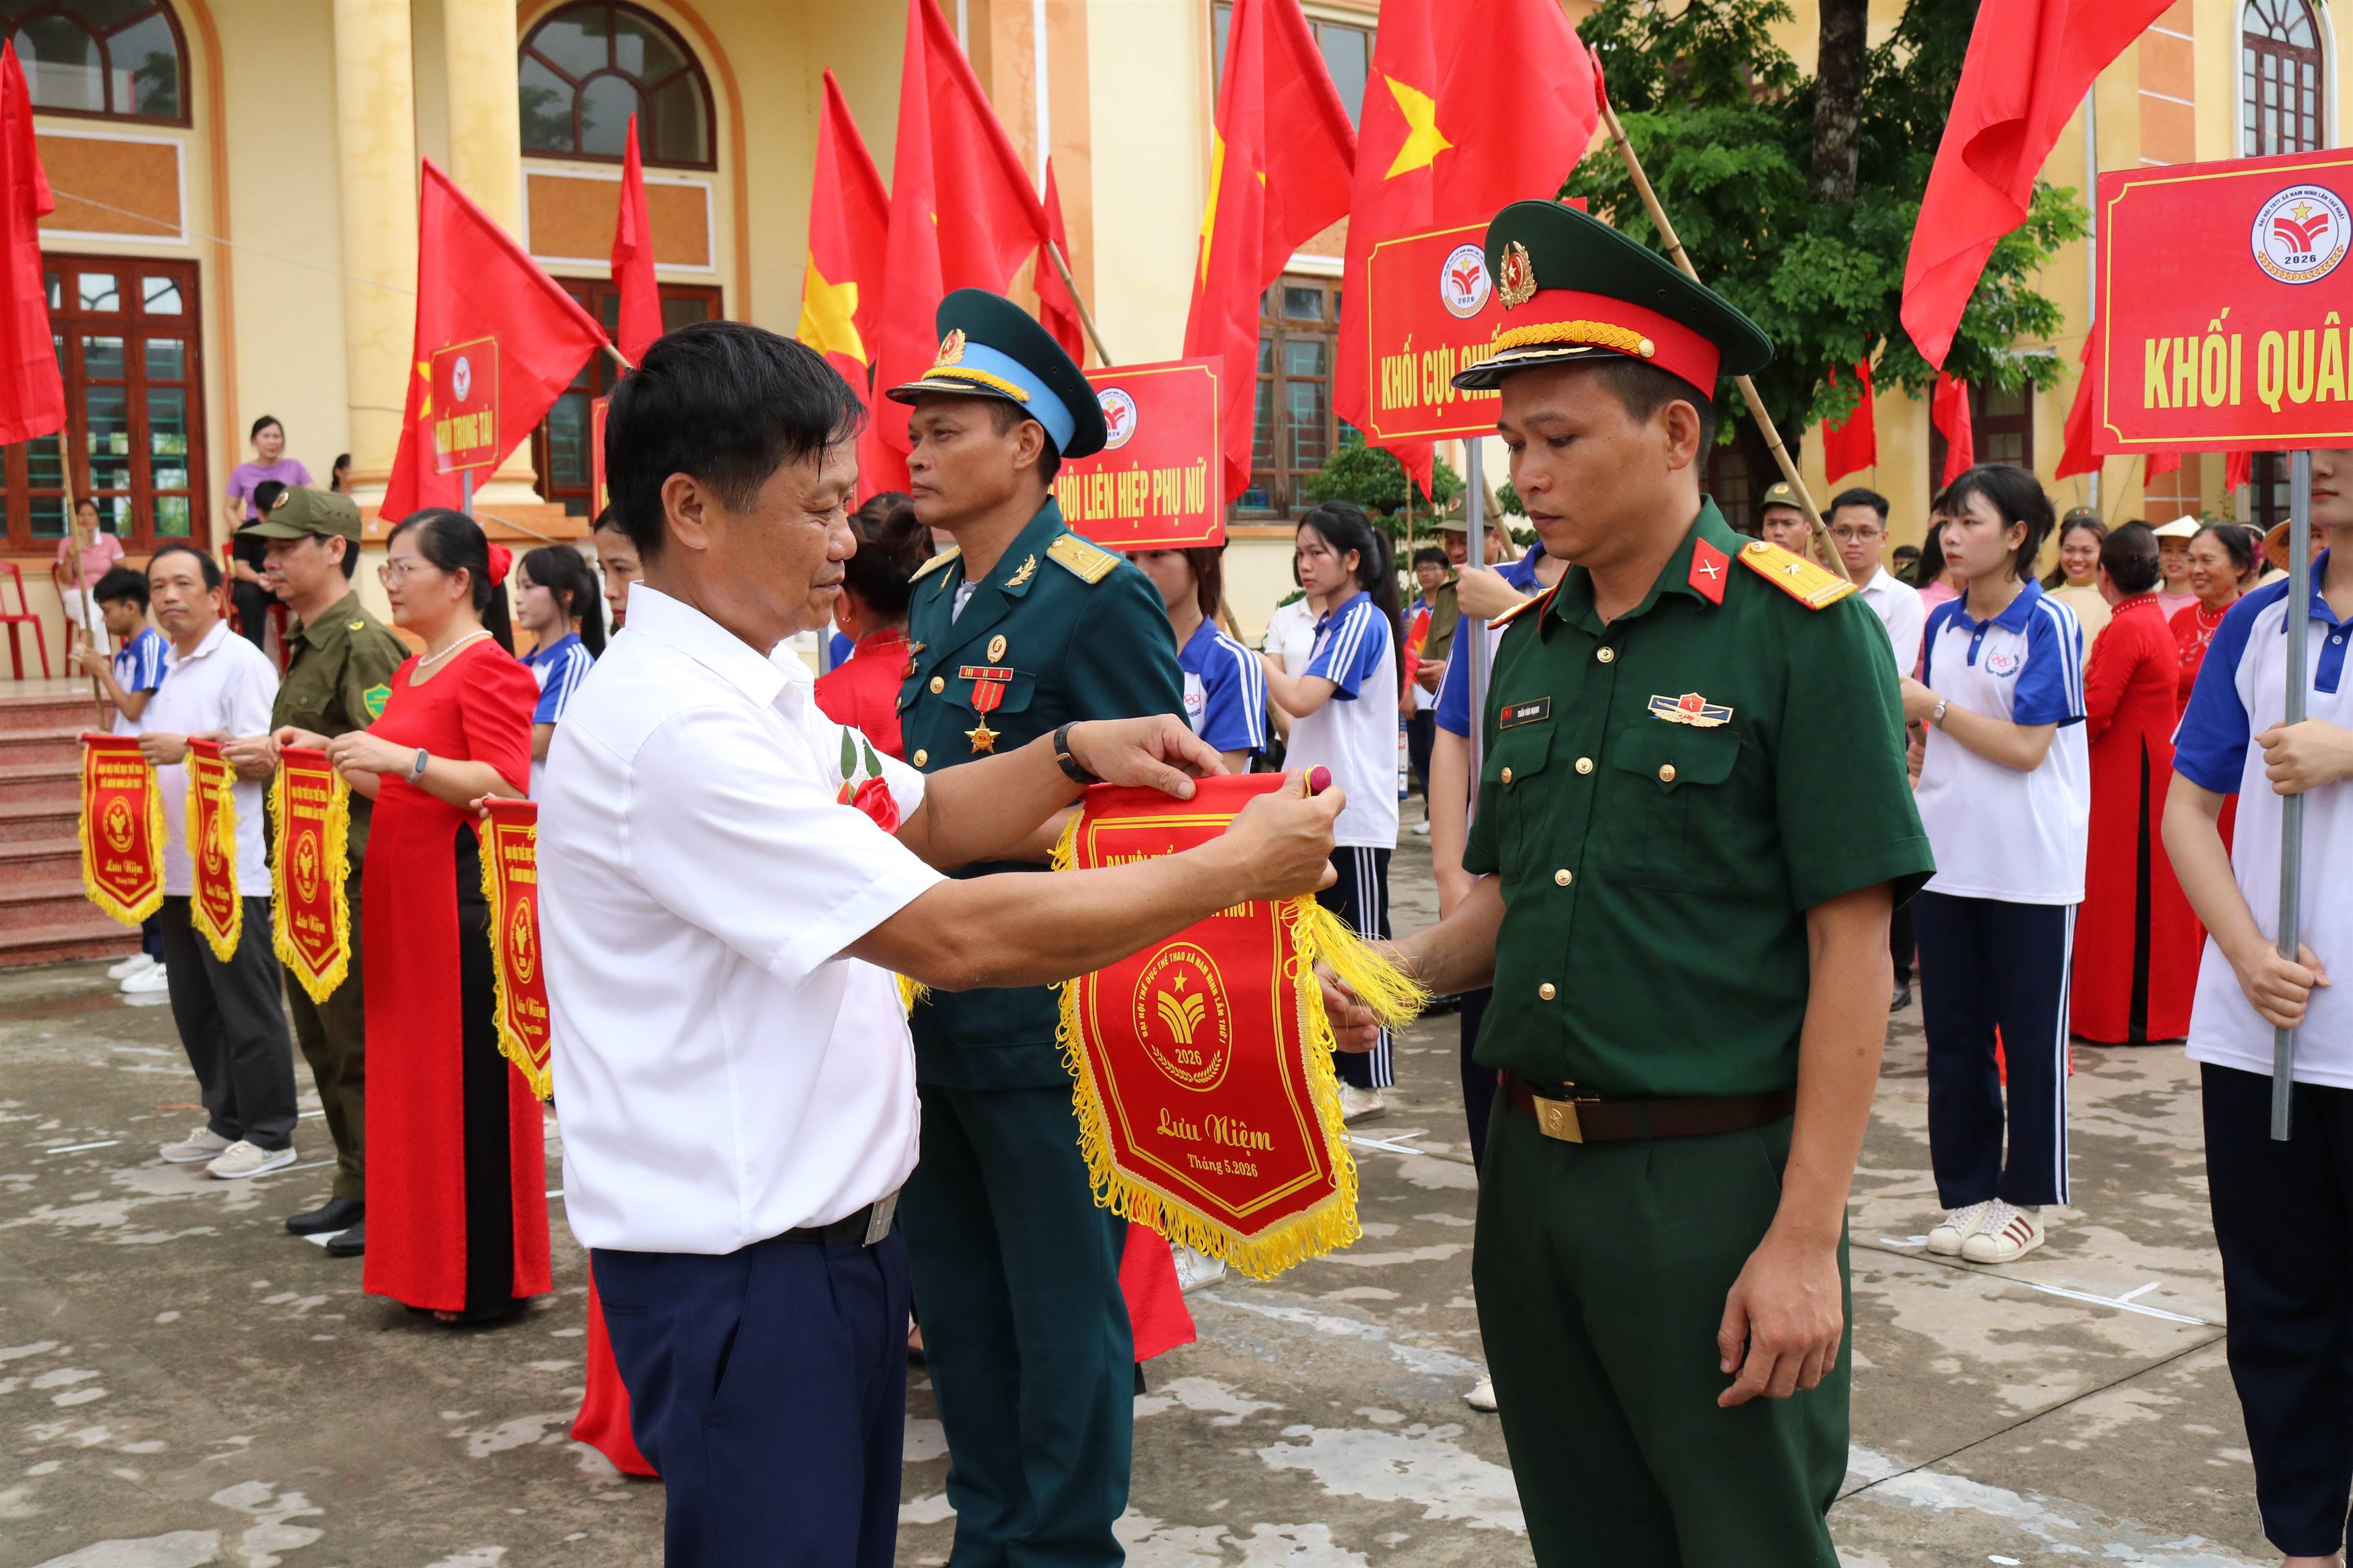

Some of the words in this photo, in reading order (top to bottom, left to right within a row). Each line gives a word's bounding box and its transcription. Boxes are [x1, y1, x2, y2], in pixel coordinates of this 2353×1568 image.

[2270, 199, 2281, 209] TDTT
[2285, 254, 2316, 264] 2026
[1381, 334, 1418, 410] KHỐI
[1422, 343, 1455, 417] CỰU
[2144, 307, 2242, 409] KHỐI
[1058, 465, 1081, 531] HỘI
[1084, 463, 1114, 520] LIÊN
[1118, 460, 1149, 528] HIỆP
[1153, 468, 1181, 526] PHỤ
[1185, 456, 1207, 514] NỮ
[1137, 1005, 1147, 1019] HỘI
[1169, 951, 1185, 961] THAO
[1195, 957, 1209, 976] NAM
[1206, 972, 1218, 997] NINH
[1175, 1048, 1202, 1066] 2026
[1157, 1107, 1203, 1142] Lưu
[1205, 1114, 1275, 1157] Niệm
[1187, 1153, 1224, 1175] Tháng
[1224, 1159, 1258, 1177] 5.2026
